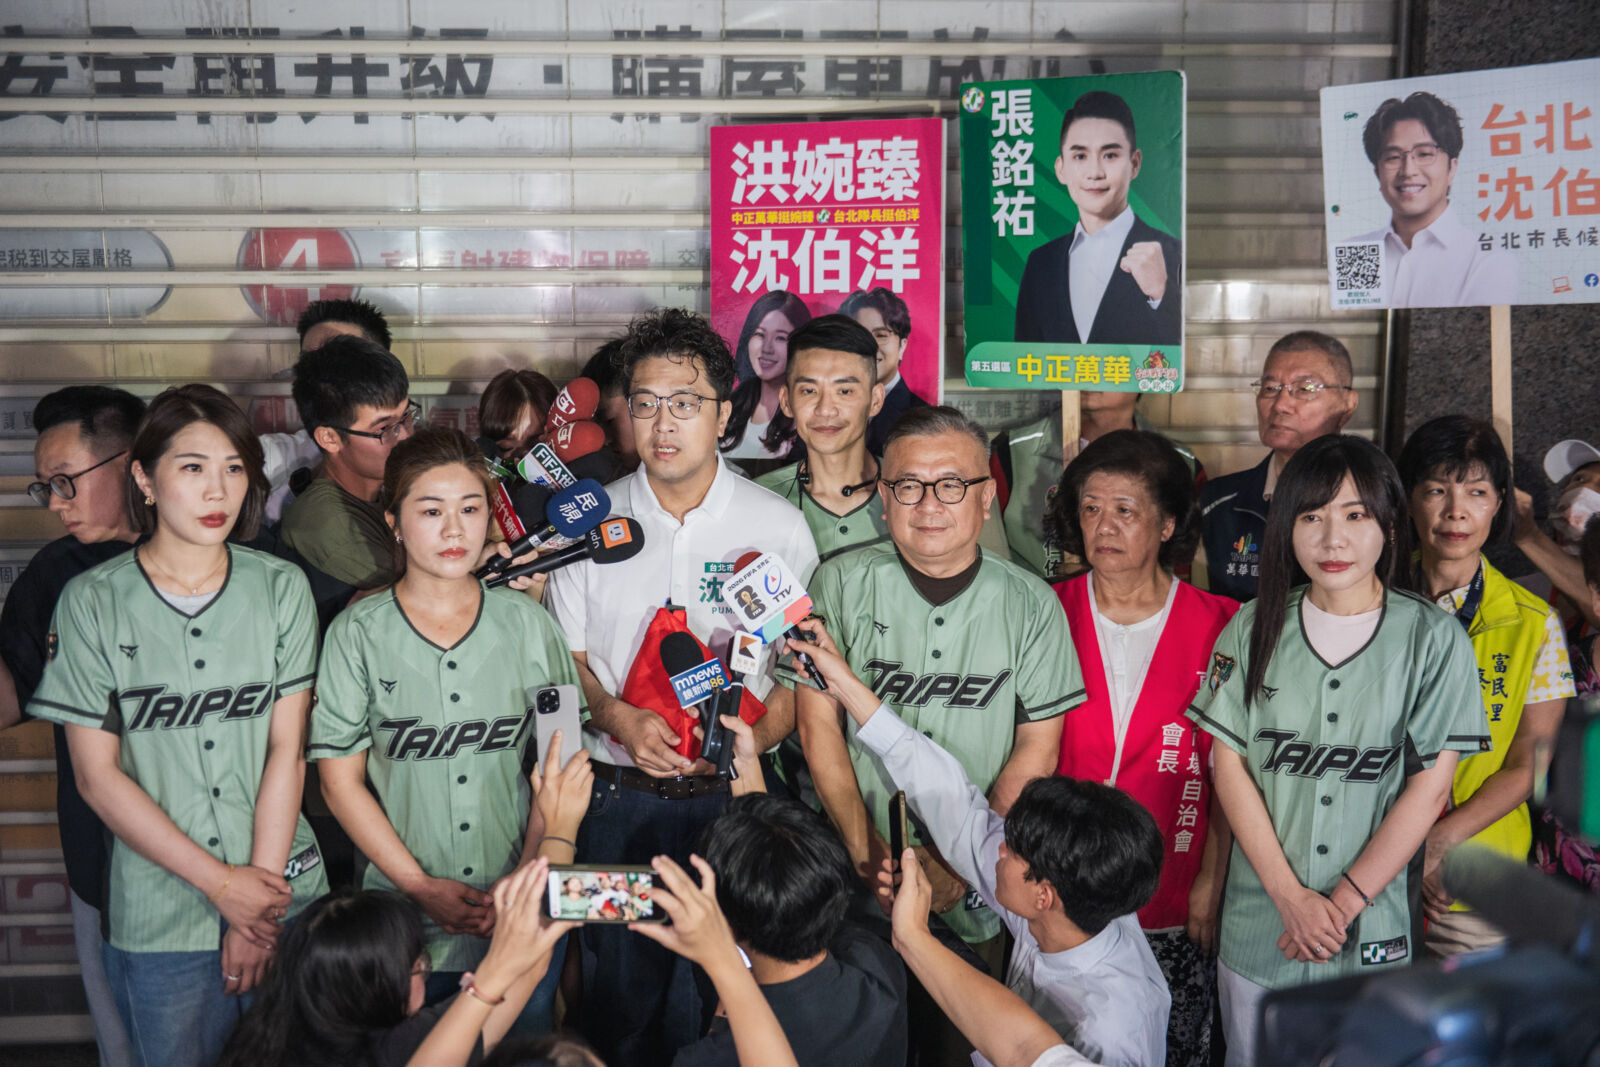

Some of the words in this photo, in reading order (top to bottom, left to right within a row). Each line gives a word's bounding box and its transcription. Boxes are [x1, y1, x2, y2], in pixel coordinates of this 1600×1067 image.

[1479, 101, 1594, 157] 台北
[730, 135, 921, 205] 洪婉臻
[990, 88, 1036, 238] 張銘祐
[1476, 166, 1600, 223] 沈伯
[729, 227, 921, 294] 沈伯洋
[1017, 353, 1131, 385] 中正萬華
[558, 491, 600, 525] 民視
[711, 607, 735, 615] PUM
[772, 585, 793, 603] TTV
[674, 663, 722, 692] mnews
[862, 658, 1014, 710] TAIPEI
[1490, 652, 1511, 722] 富民里
[1156, 722, 1186, 775] 會長
